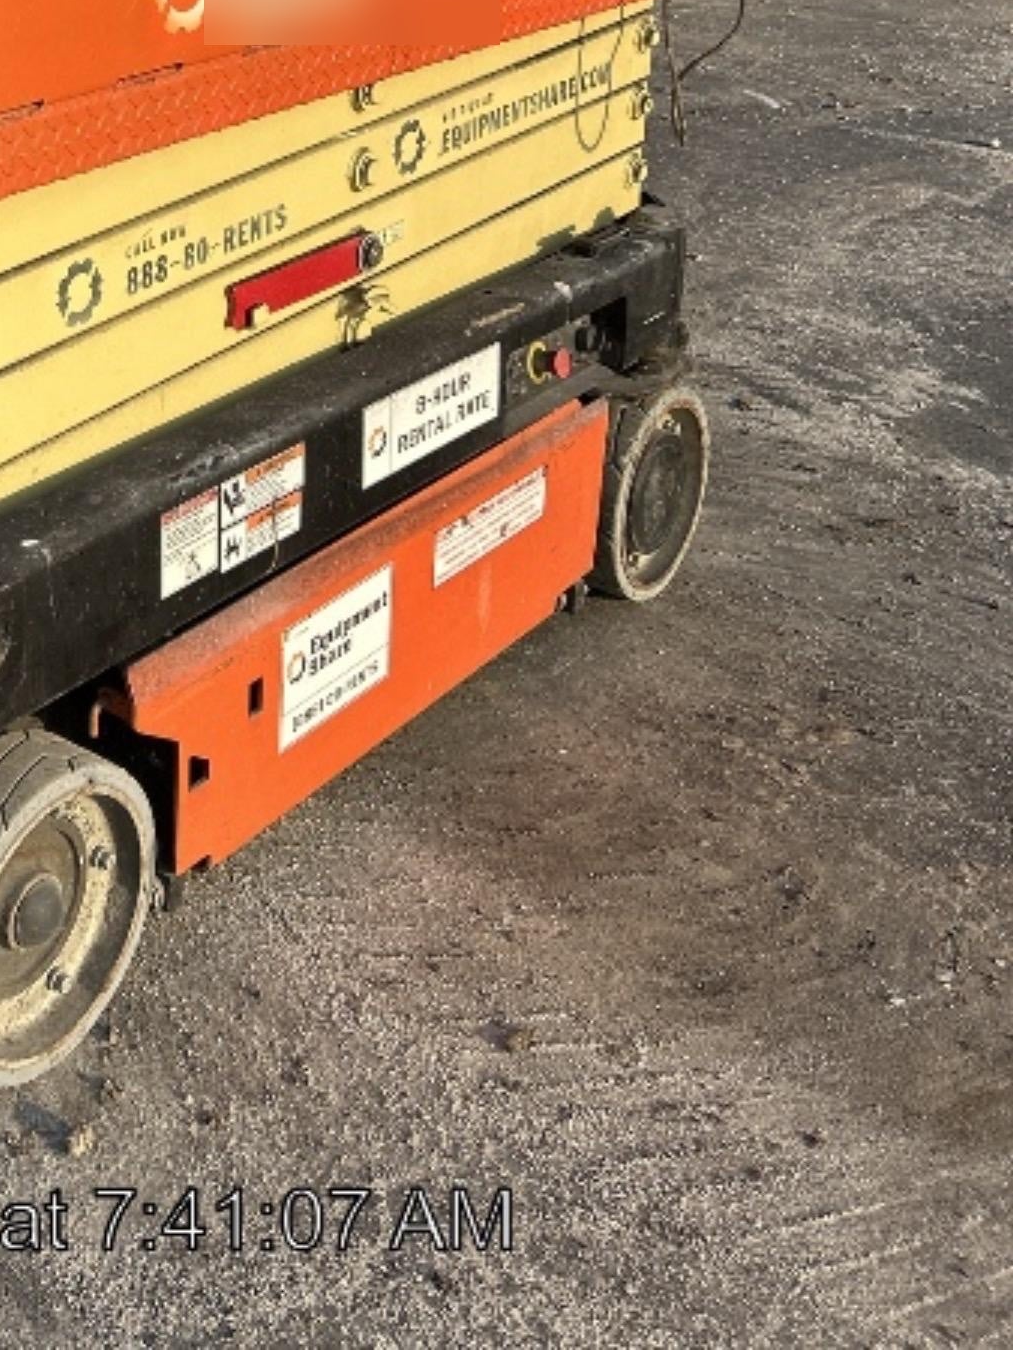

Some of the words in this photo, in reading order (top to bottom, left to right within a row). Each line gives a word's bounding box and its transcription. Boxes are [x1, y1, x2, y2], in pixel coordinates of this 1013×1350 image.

[397, 410, 452, 454] RENTAL
[310, 590, 388, 655] Equipment
[308, 638, 352, 677] Share
